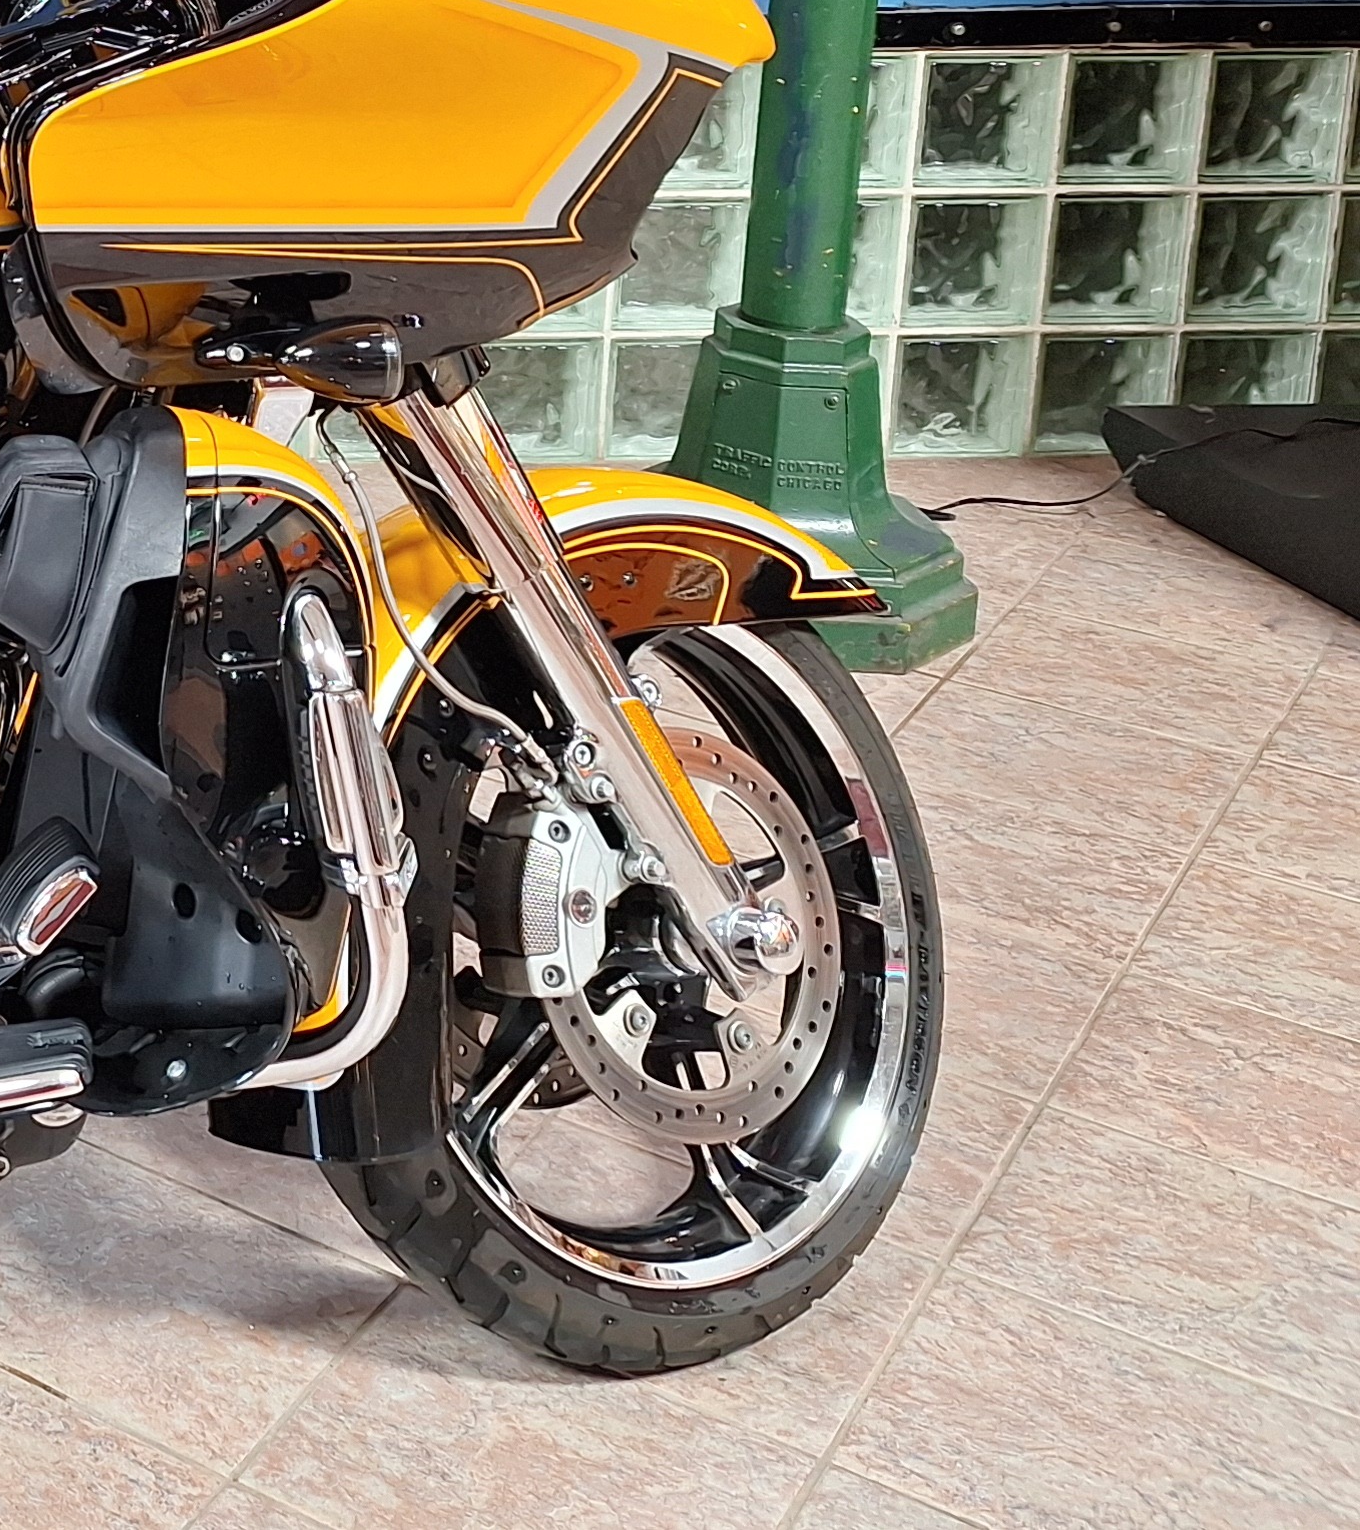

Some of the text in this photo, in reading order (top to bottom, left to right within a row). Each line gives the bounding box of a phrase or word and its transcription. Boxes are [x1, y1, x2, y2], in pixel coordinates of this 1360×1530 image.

[713, 442, 845, 476] TRAFFIC CONTROL
[777, 474, 842, 491] CHICAGO
